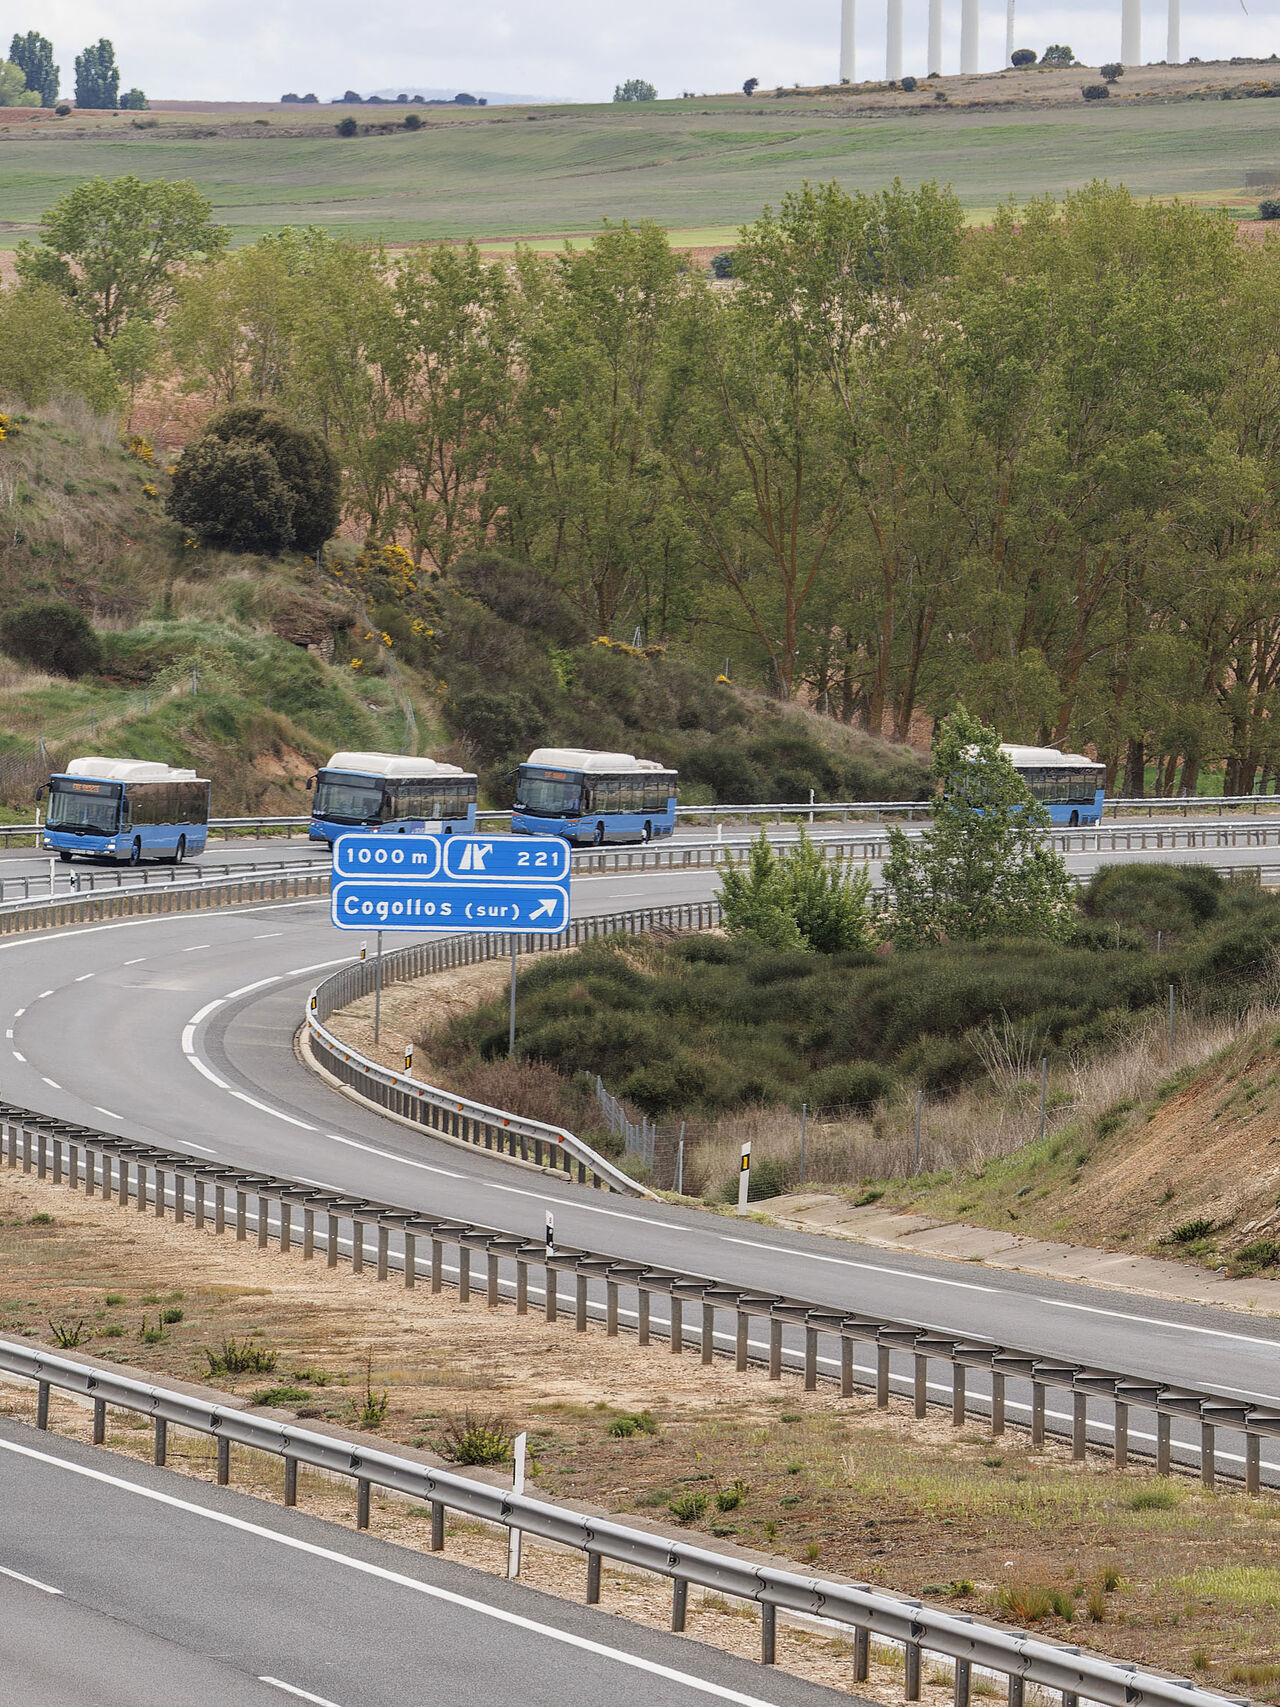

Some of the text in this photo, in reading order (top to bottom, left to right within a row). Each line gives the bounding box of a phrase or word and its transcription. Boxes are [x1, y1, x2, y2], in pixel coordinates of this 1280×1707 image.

[347, 848, 428, 864] 1000 m
[517, 851, 559, 866] 221
[344, 895, 520, 921] Cogollos (sur)
